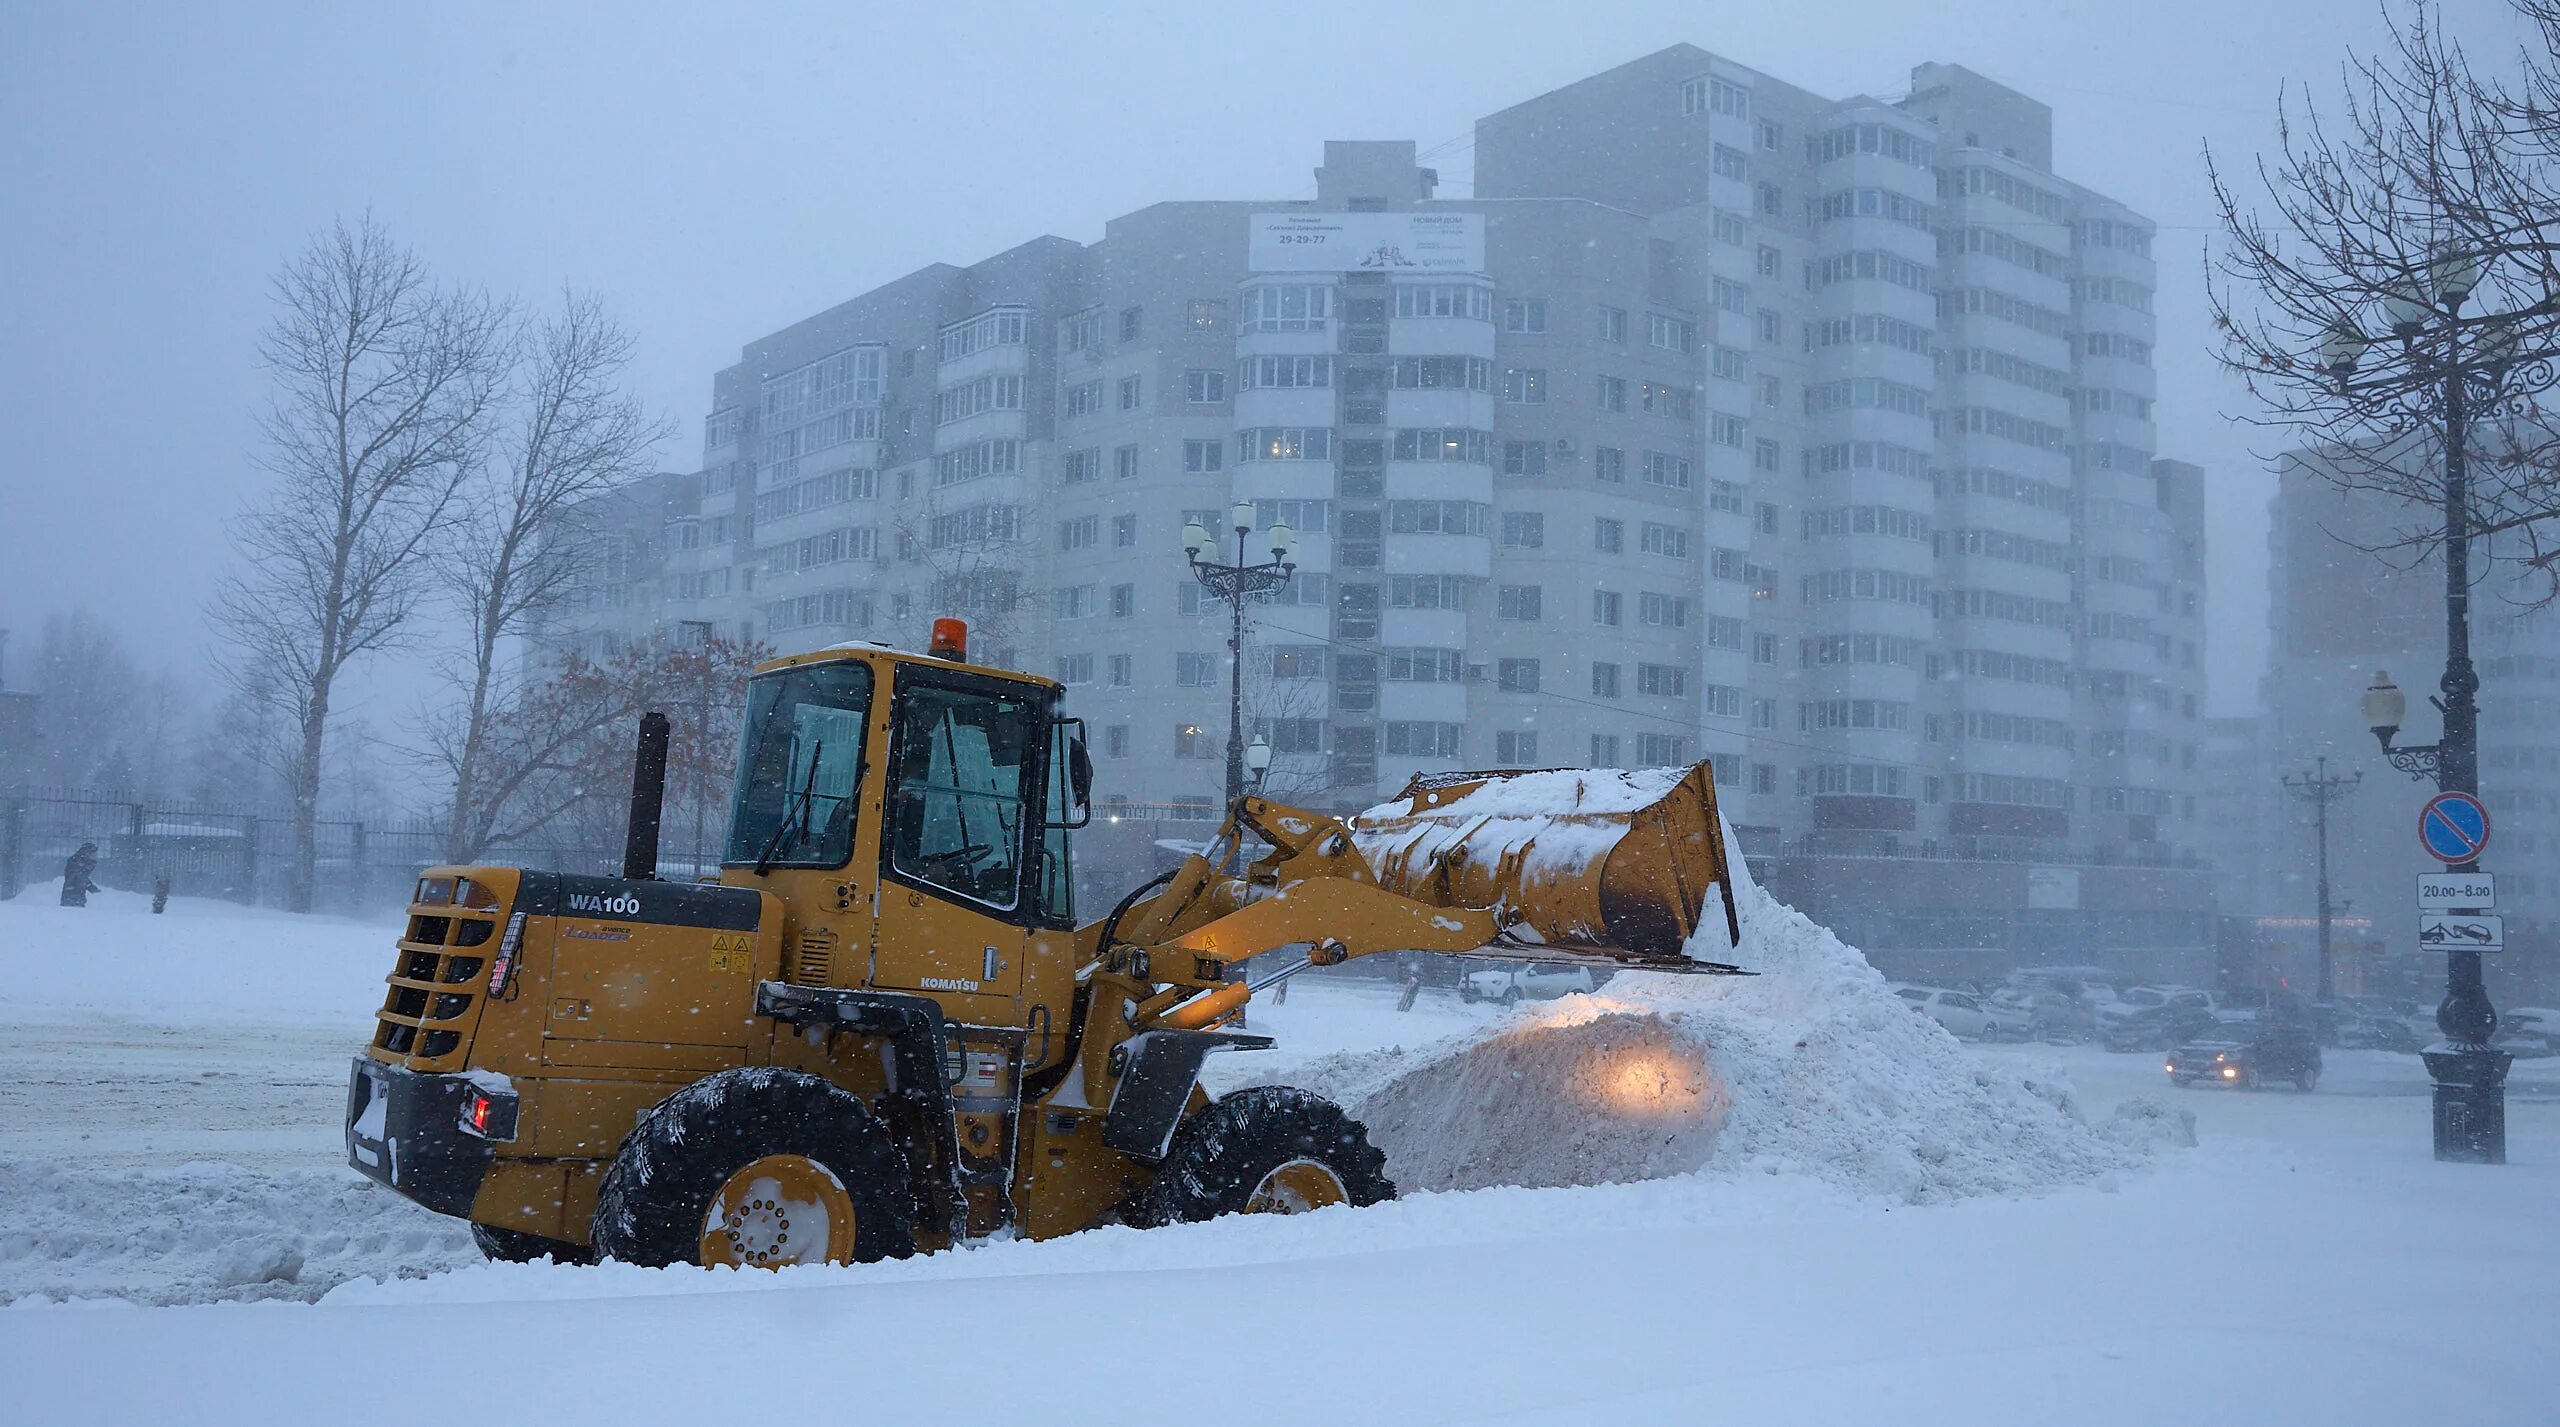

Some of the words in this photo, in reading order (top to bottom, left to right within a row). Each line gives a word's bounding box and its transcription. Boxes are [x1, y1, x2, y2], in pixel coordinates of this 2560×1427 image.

[1279, 235, 1326, 244] 29-29-77
[2423, 885, 2490, 898] 20.00-8.00
[569, 893, 640, 914] WA100
[920, 977, 979, 991] KOMATSU
